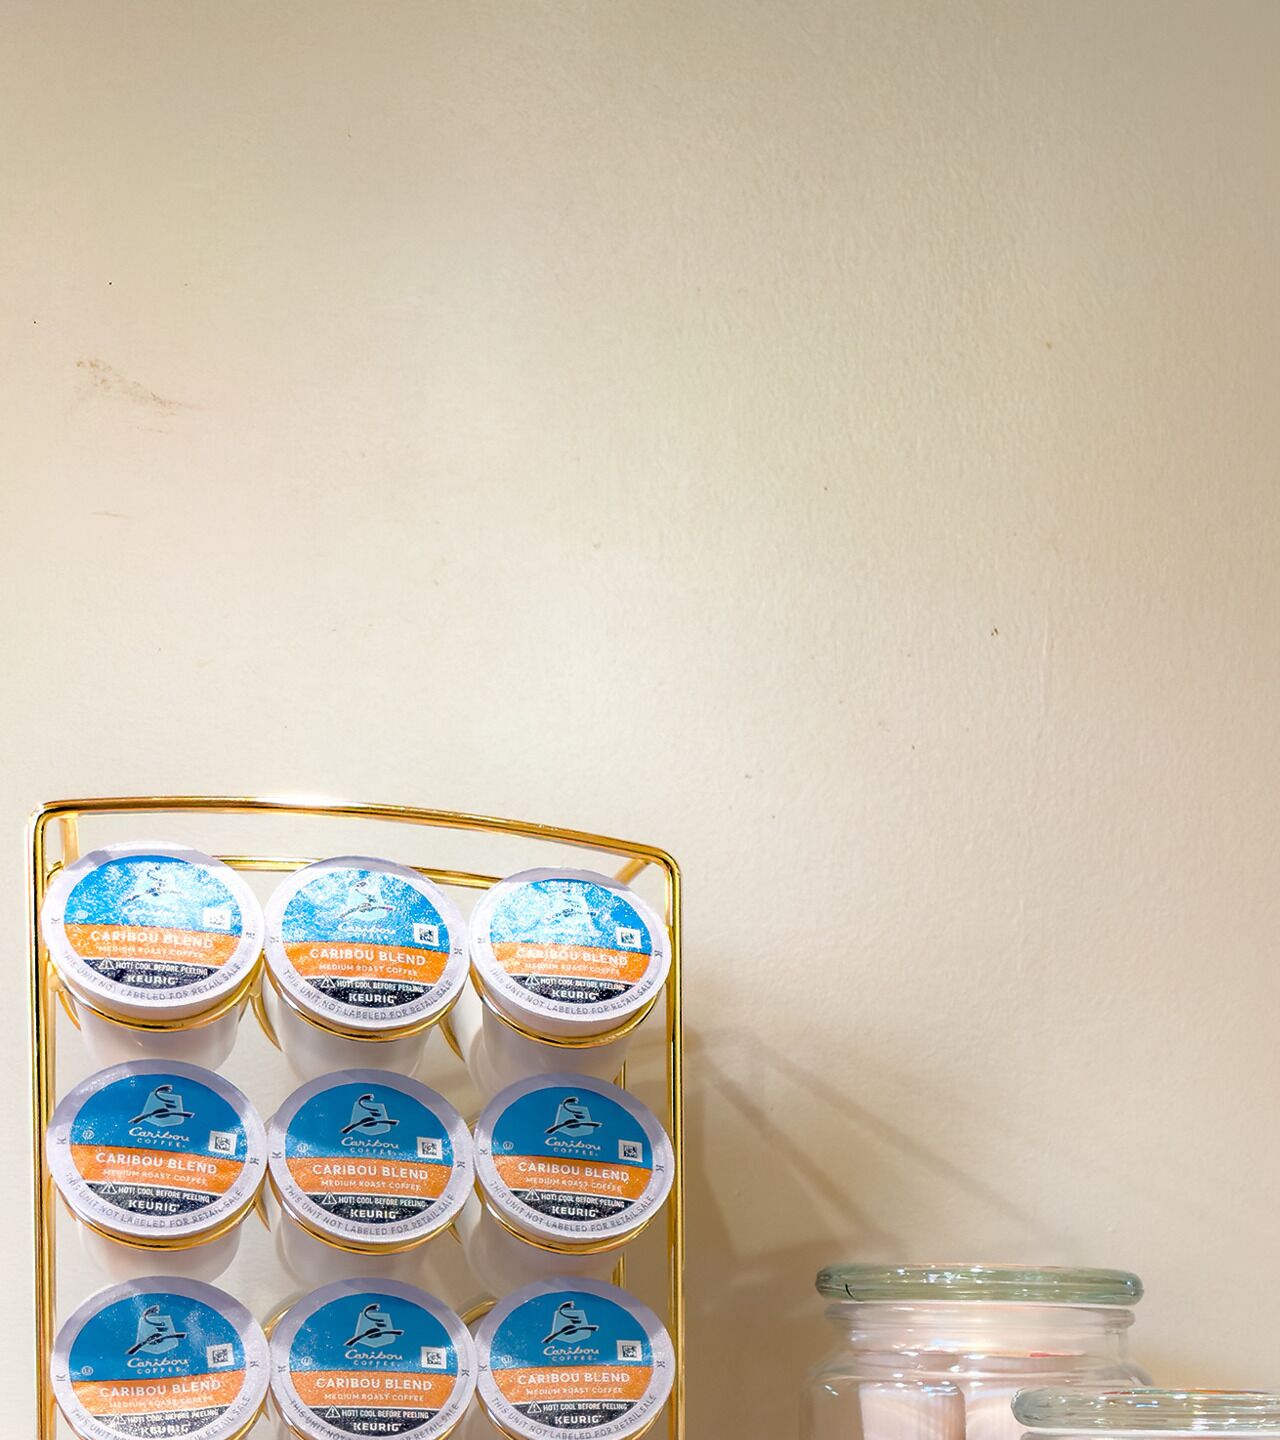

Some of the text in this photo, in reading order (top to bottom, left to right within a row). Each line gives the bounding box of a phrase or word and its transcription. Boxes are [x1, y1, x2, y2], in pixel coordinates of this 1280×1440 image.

[90, 930, 214, 950] CARIBOU BLEND
[309, 948, 426, 966] CARIBOU BLEND
[516, 949, 628, 967] CARIBOU BLEND
[126, 974, 178, 986] KEURIG
[348, 993, 396, 1004] KEURIG
[552, 989, 597, 1000] KEURIG
[128, 1126, 191, 1142] Caribou
[341, 1137, 400, 1149] Caribou
[545, 1136, 601, 1150] Caribou
[95, 1152, 218, 1175] CARIBOU BLEND
[312, 1164, 429, 1180] CARIBOU BLEND
[518, 1161, 630, 1182] CARIBOU BLEND
[128, 1200, 178, 1212] KEURIG
[552, 1206, 597, 1217] KEURIG
[350, 1209, 396, 1219] KEURIG
[344, 1349, 403, 1360] Caribou
[543, 1345, 600, 1356] Caribou
[316, 1378, 432, 1391] CARIBOU BLEND
[518, 1372, 630, 1385] CARIBOU BLEND
[100, 1380, 221, 1398] CARIBOU BLEND
[554, 1415, 599, 1424] KEURIG
[141, 1425, 189, 1436] KEURIG
[353, 1422, 400, 1432] KEURIG
